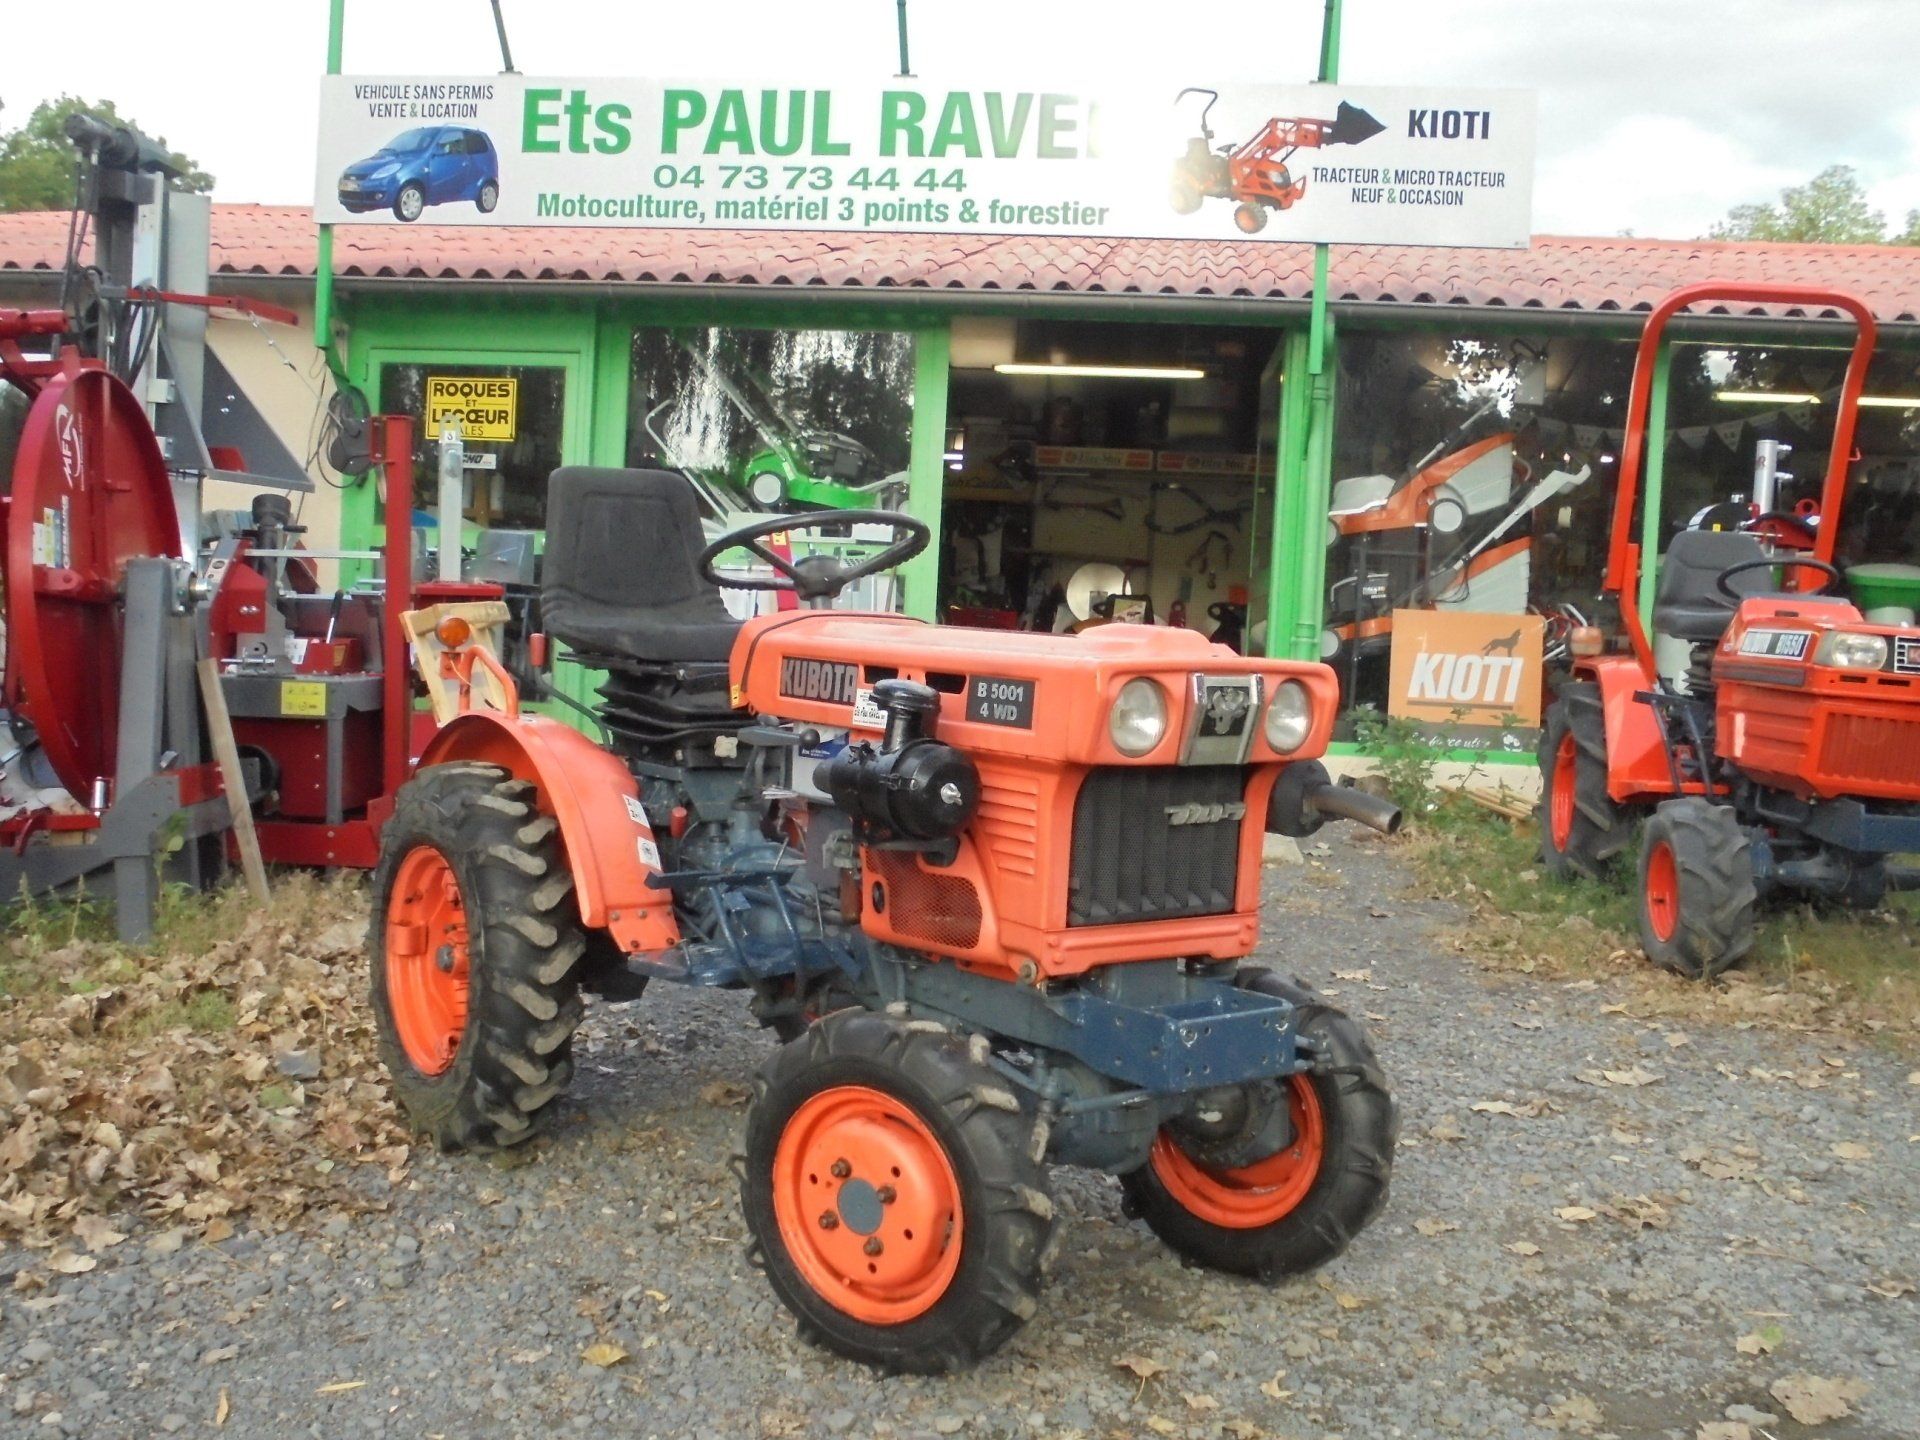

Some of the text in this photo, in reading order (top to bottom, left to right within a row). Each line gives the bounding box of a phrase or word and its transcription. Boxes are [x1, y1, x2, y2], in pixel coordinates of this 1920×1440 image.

[355, 85, 494, 100] VEHICULE SANS PERMIS
[369, 103, 478, 118] VENTE & LOCATION
[522, 89, 631, 154] Ets
[661, 89, 851, 156] PAUL
[1407, 110, 1491, 140] KIOTI
[653, 165, 967, 192] 04 73 73 44 44
[1312, 167, 1505, 188] TRACTEUR & MICRO TRACTEUR
[1352, 188, 1464, 206] NEUF & OCCASION
[537, 193, 1109, 226] Motoculture, matériel 3 points & forestier
[433, 382, 510, 398] ROQUES
[465, 399, 477, 407] ET
[780, 658, 859, 704] KUBOTA
[1407, 652, 1524, 702] KIOTI
[977, 682, 1024, 702] B 5001
[980, 702, 1017, 721] 4 WD
